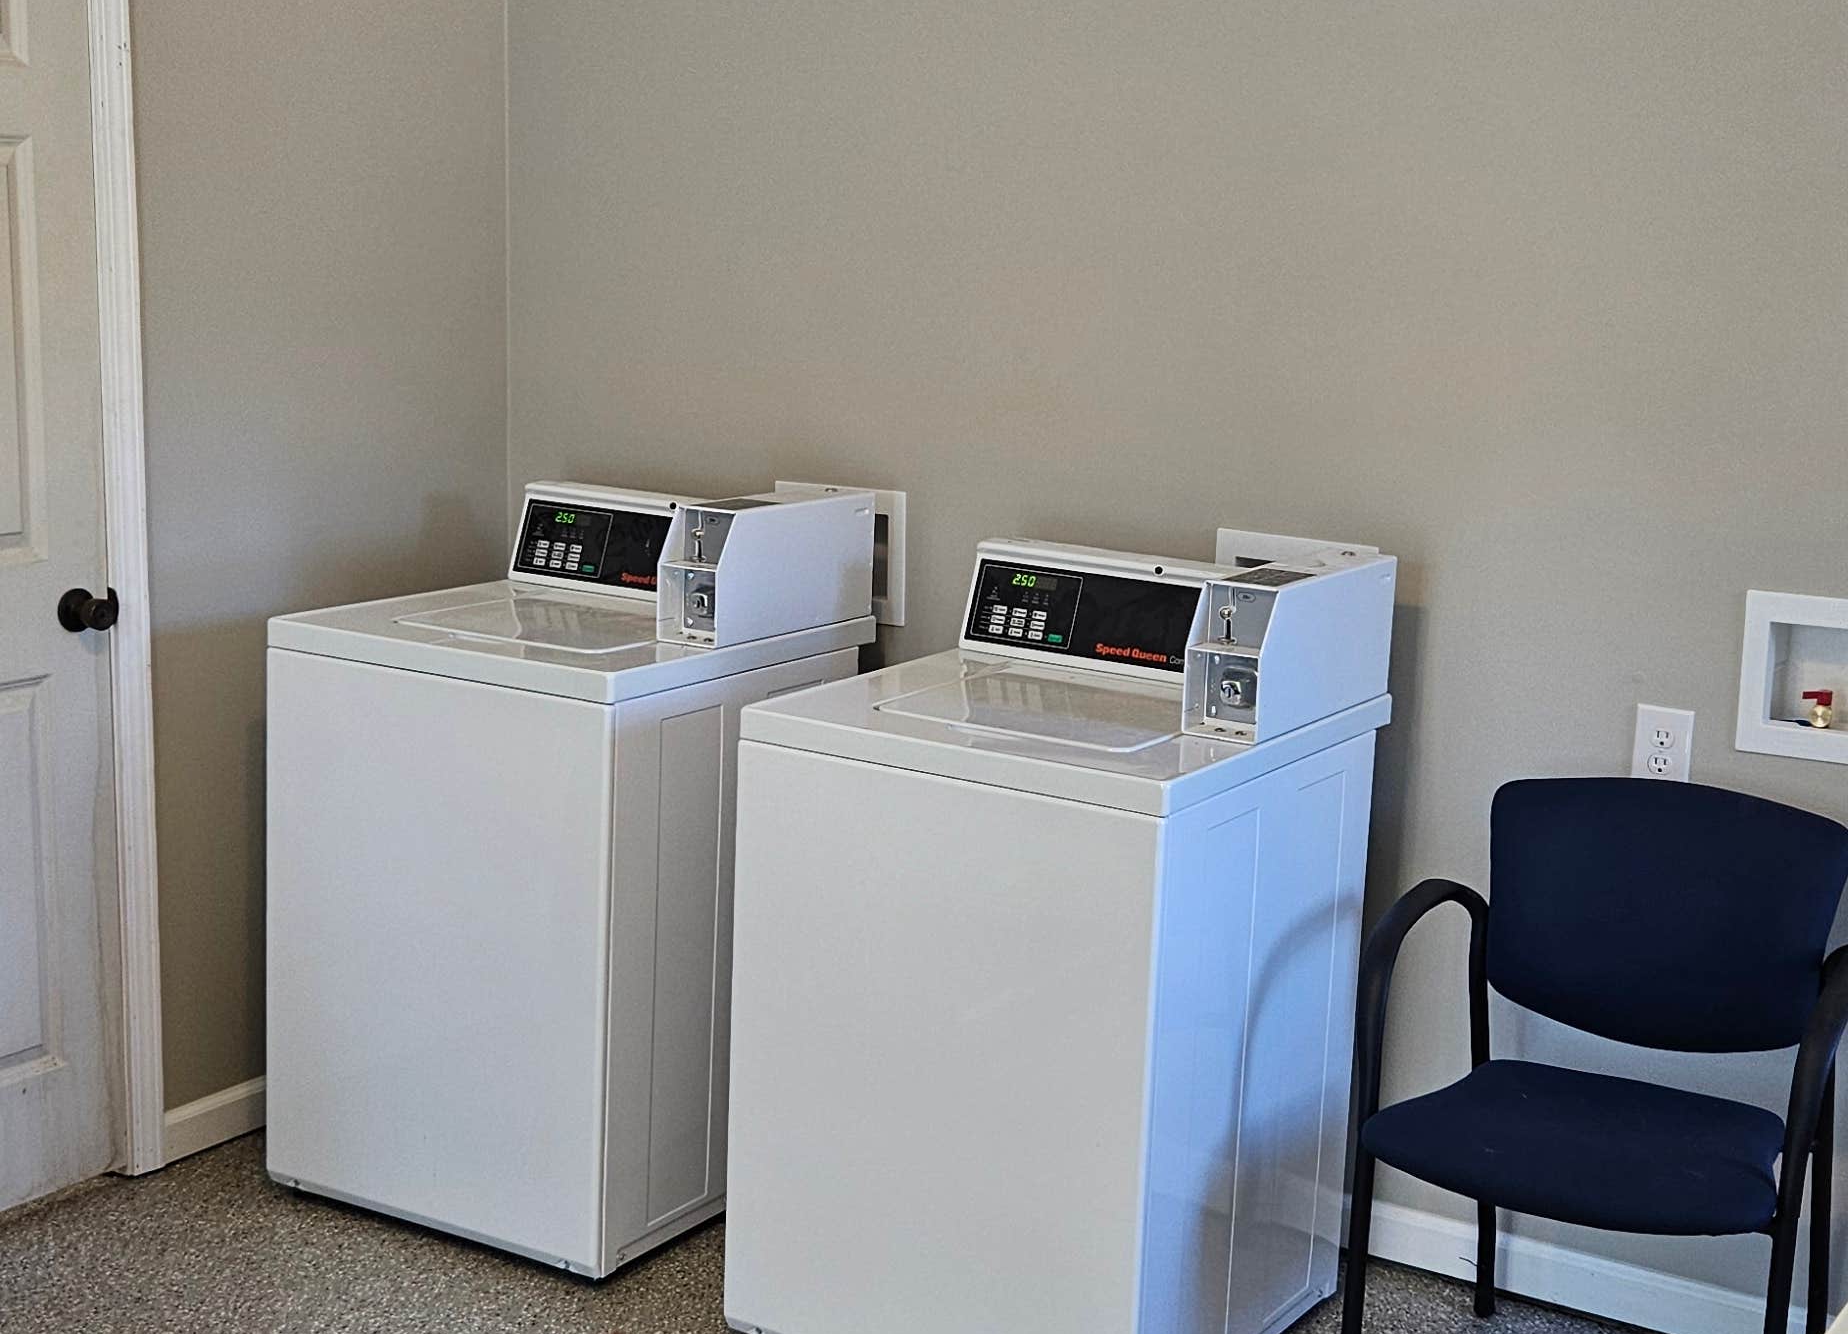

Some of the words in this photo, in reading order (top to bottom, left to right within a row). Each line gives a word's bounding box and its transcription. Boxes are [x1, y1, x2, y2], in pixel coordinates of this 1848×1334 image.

[620, 572, 651, 585] Speed
[1012, 573, 1037, 588] 250
[1095, 642, 1131, 657] Speed
[1131, 648, 1168, 663] Queen
